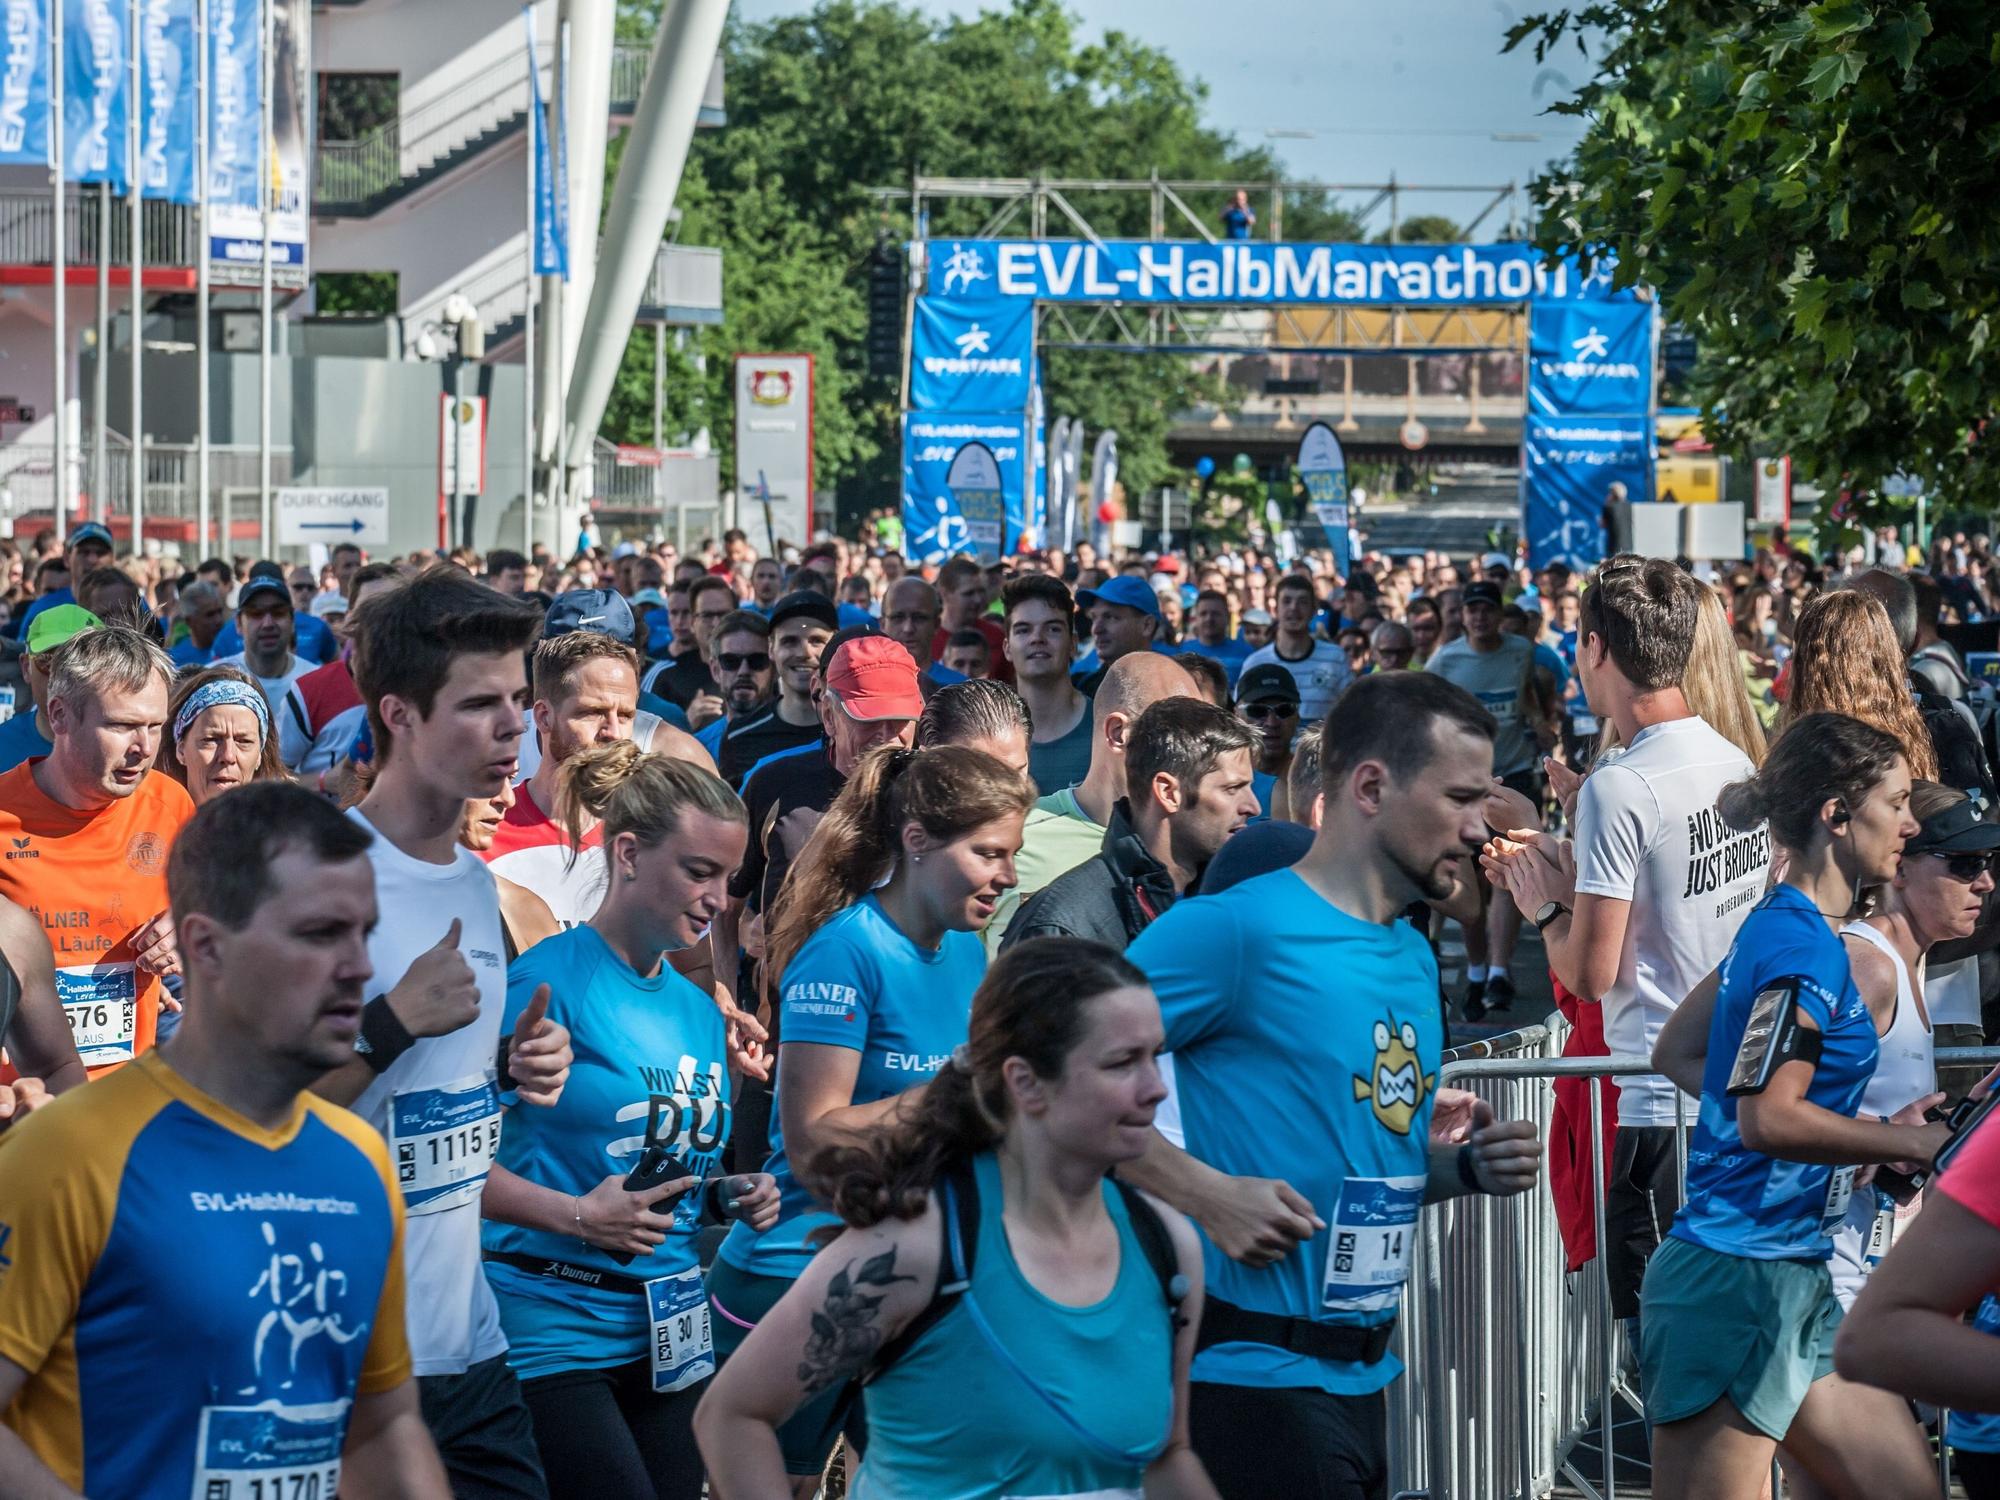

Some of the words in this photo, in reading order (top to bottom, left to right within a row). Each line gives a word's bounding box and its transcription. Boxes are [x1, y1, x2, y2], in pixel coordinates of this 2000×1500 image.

[998, 244, 1568, 299] EVL-HalbMarathon
[283, 492, 385, 508] DURCHGANG
[1687, 808, 1713, 856] NO
[6, 849, 40, 860] erima
[1683, 849, 1722, 899] JUST
[1724, 828, 1770, 885] BRIDGES
[60, 935, 113, 952] Läufe
[786, 982, 857, 1007] HAANER
[638, 1065, 723, 1098] WILLST
[643, 1093, 725, 1154] DU
[427, 1125, 482, 1166] 1115
[190, 1191, 360, 1215] EVL-HalbMarathon
[1382, 1230, 1402, 1261] 14
[561, 1265, 602, 1285] bunert
[677, 1314, 692, 1343] 30
[250, 1472, 320, 1500] 1170
